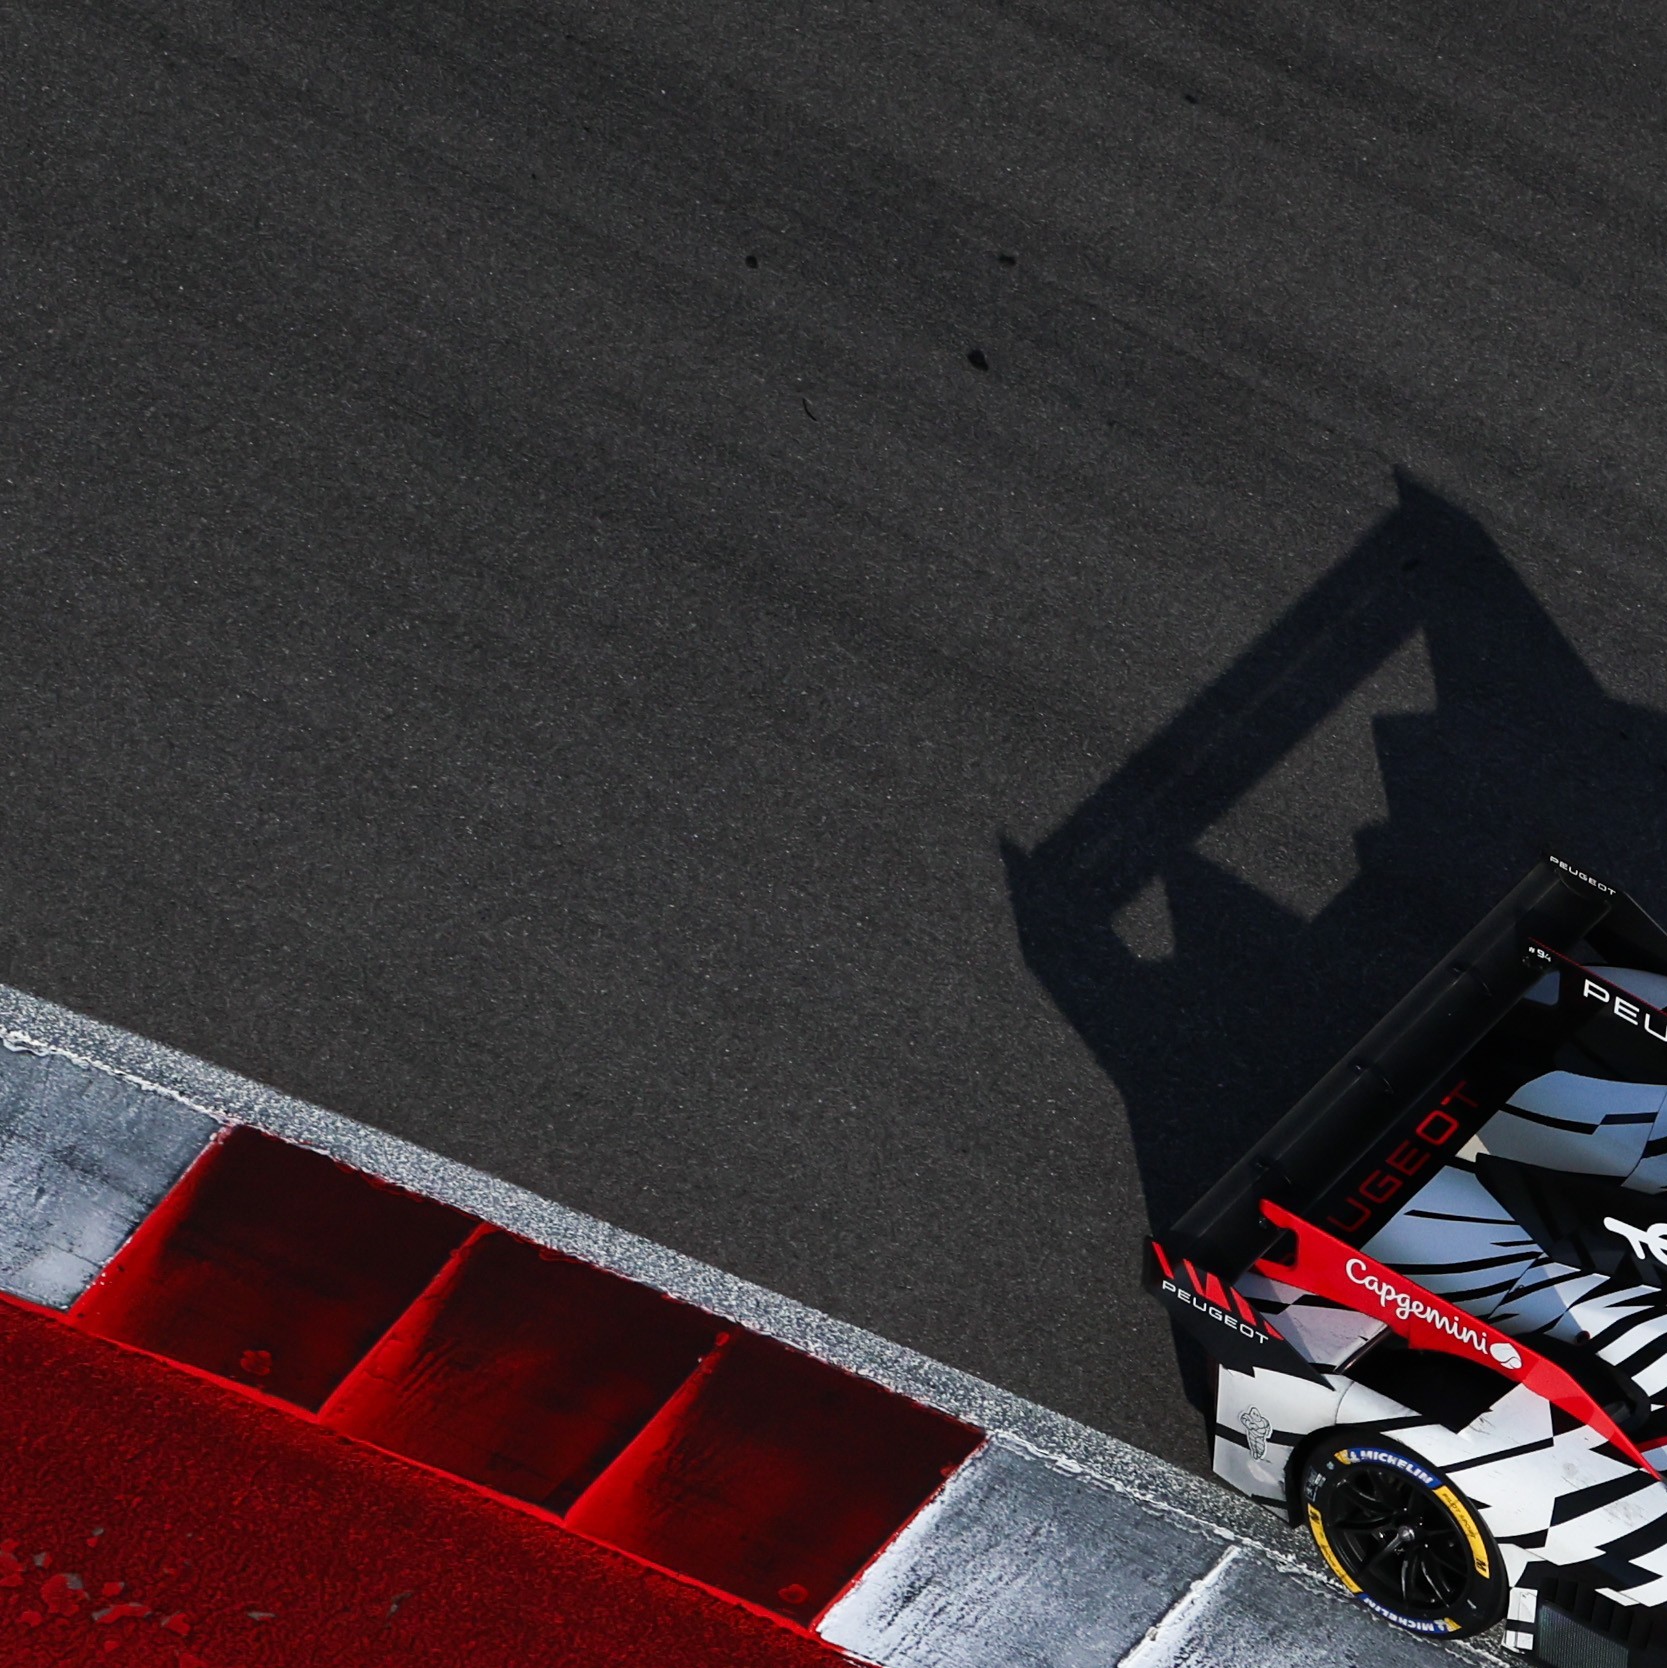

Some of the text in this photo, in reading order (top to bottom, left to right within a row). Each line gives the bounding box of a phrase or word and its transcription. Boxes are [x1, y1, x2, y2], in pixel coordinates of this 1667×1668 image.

[1549, 855, 1617, 896] PEUGEOT
[1327, 1080, 1478, 1233] UGEOT
[1162, 1280, 1269, 1344] PEUGEOT
[1345, 1258, 1489, 1356] Capgemini
[1360, 1450, 1434, 1484] MICHELIN
[1363, 1596, 1436, 1632] MICHELIN
